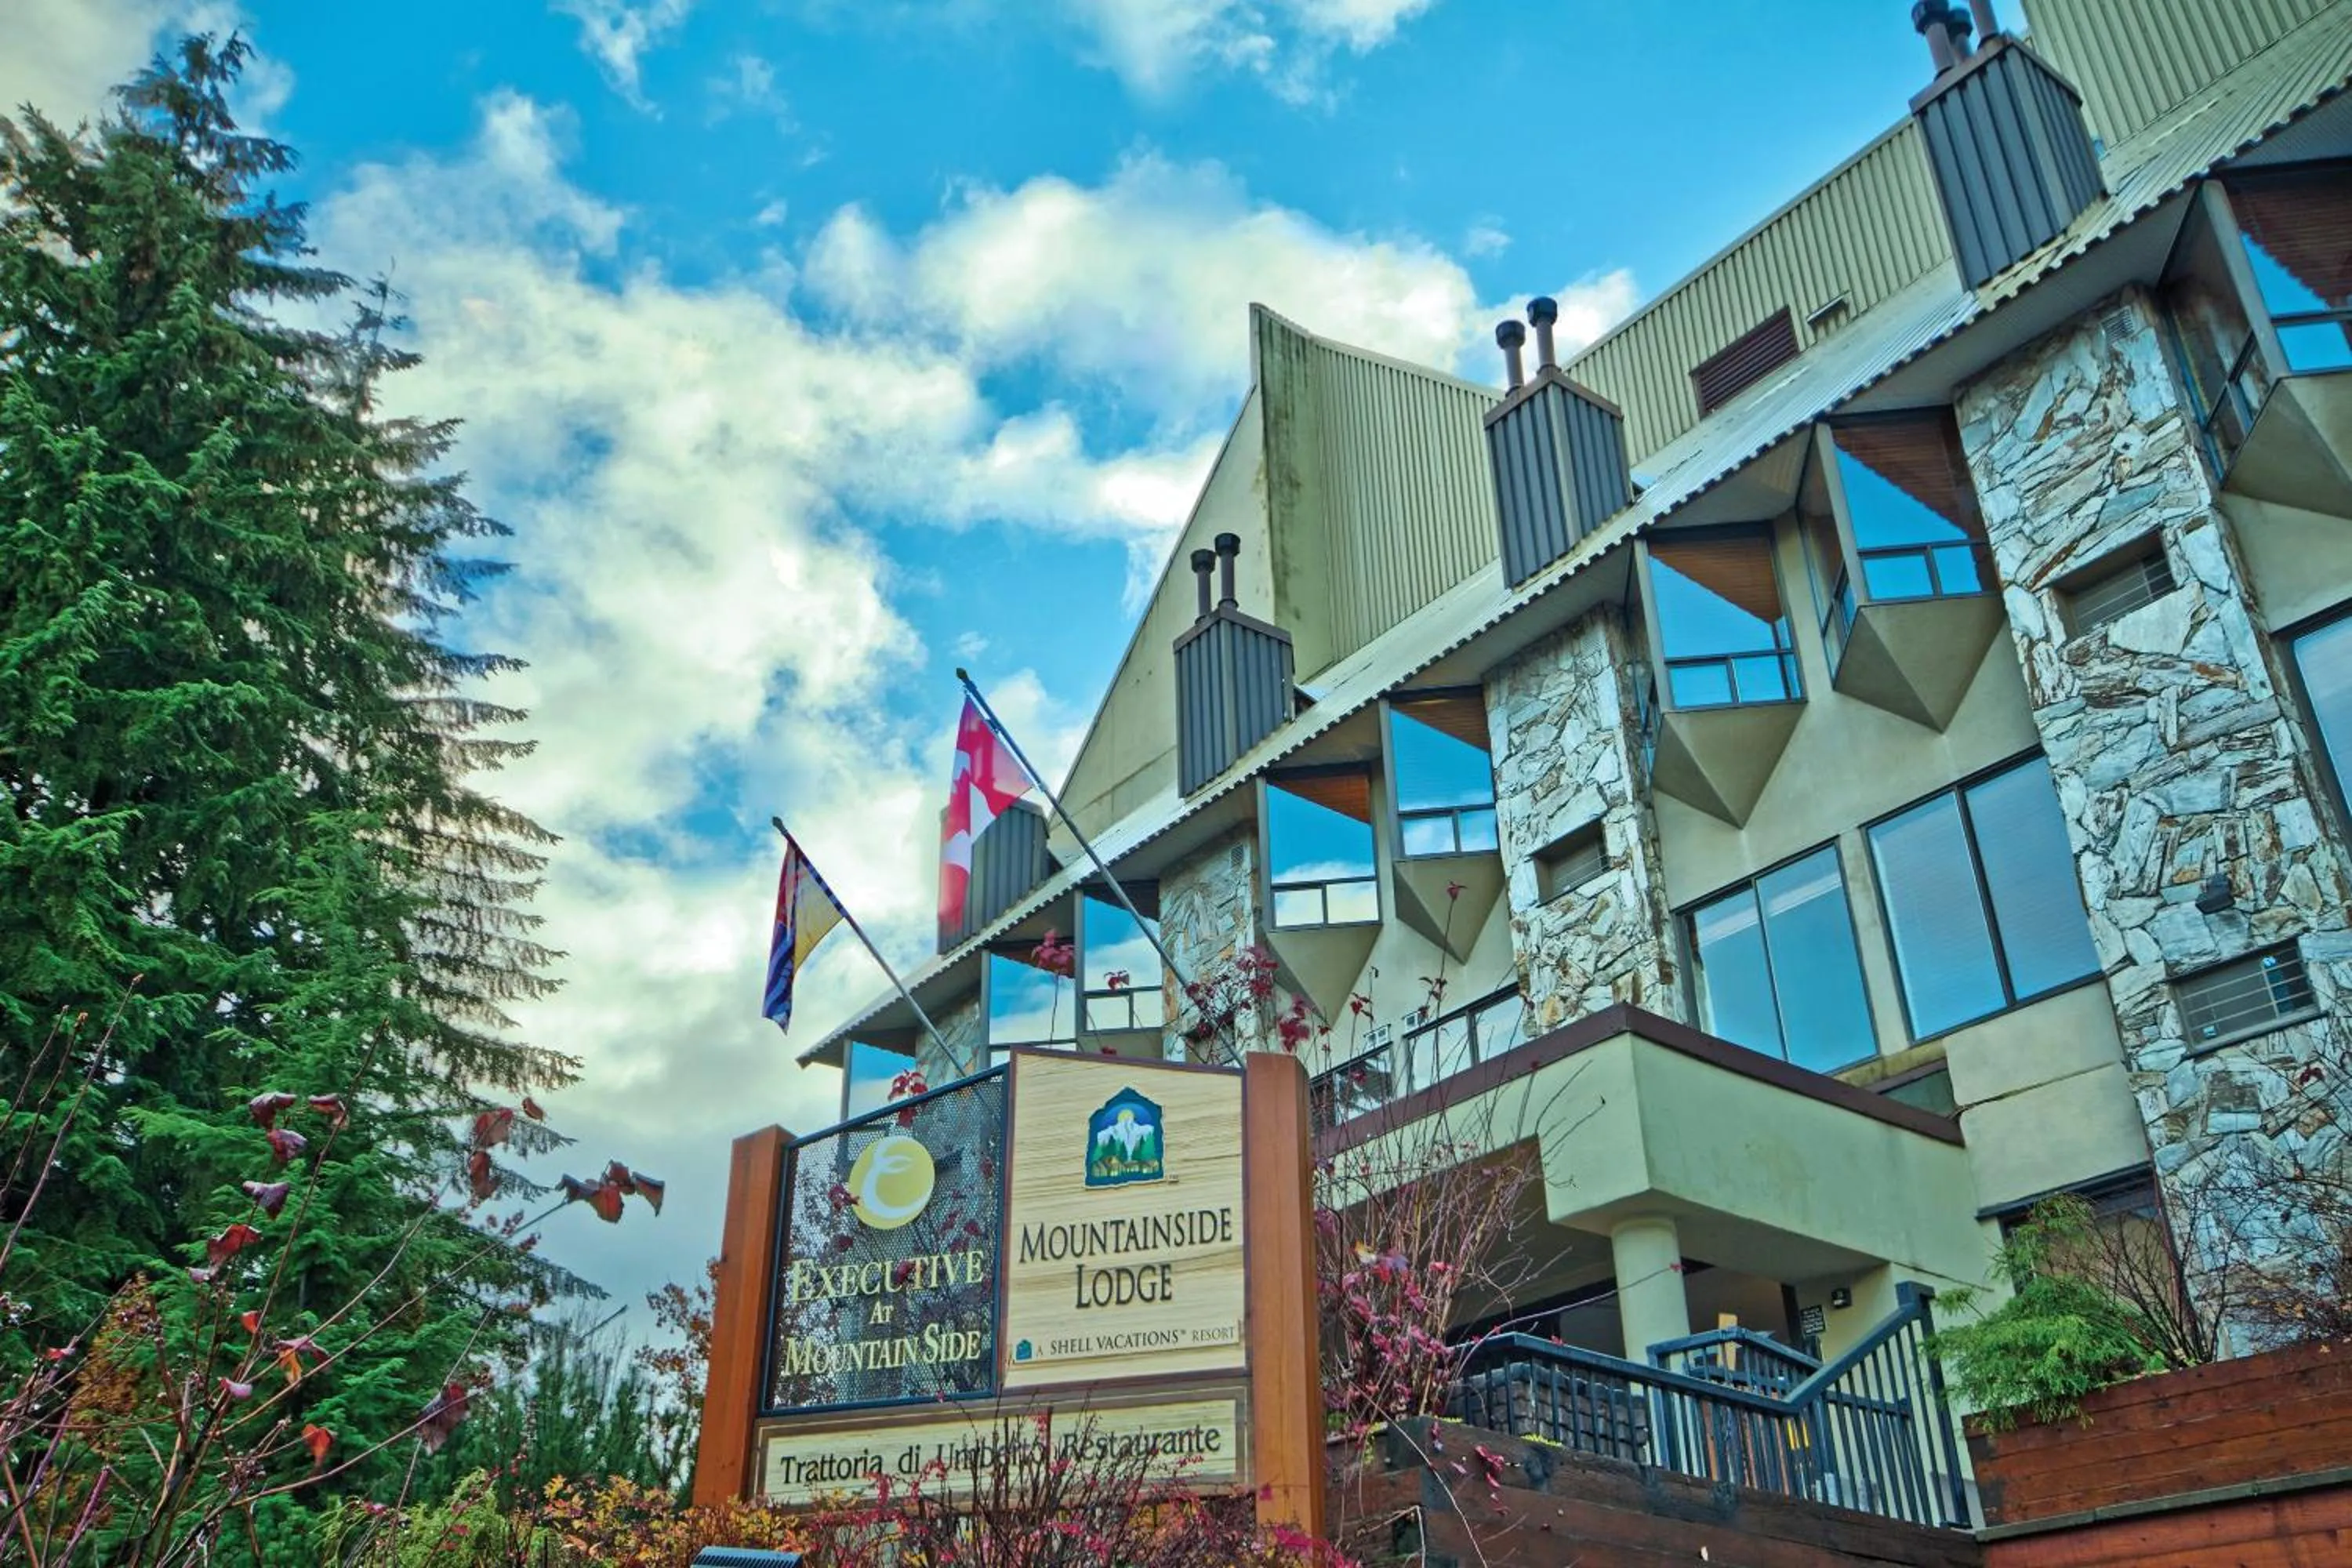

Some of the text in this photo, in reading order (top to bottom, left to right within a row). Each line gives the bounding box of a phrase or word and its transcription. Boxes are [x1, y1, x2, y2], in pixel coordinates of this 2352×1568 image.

[1019, 1208, 1232, 1263] MOUNTAINSIDE
[791, 1250, 984, 1301] EXECUTIVE
[1076, 1264, 1173, 1309] LODGE
[1036, 1345, 1044, 1356] A
[1050, 1338, 1092, 1356] SHELL
[1192, 1327, 1234, 1343] RESORT
[780, 1448, 883, 1484] Trattoria
[898, 1444, 921, 1474] di
[1062, 1424, 1221, 1461] Restaurante
